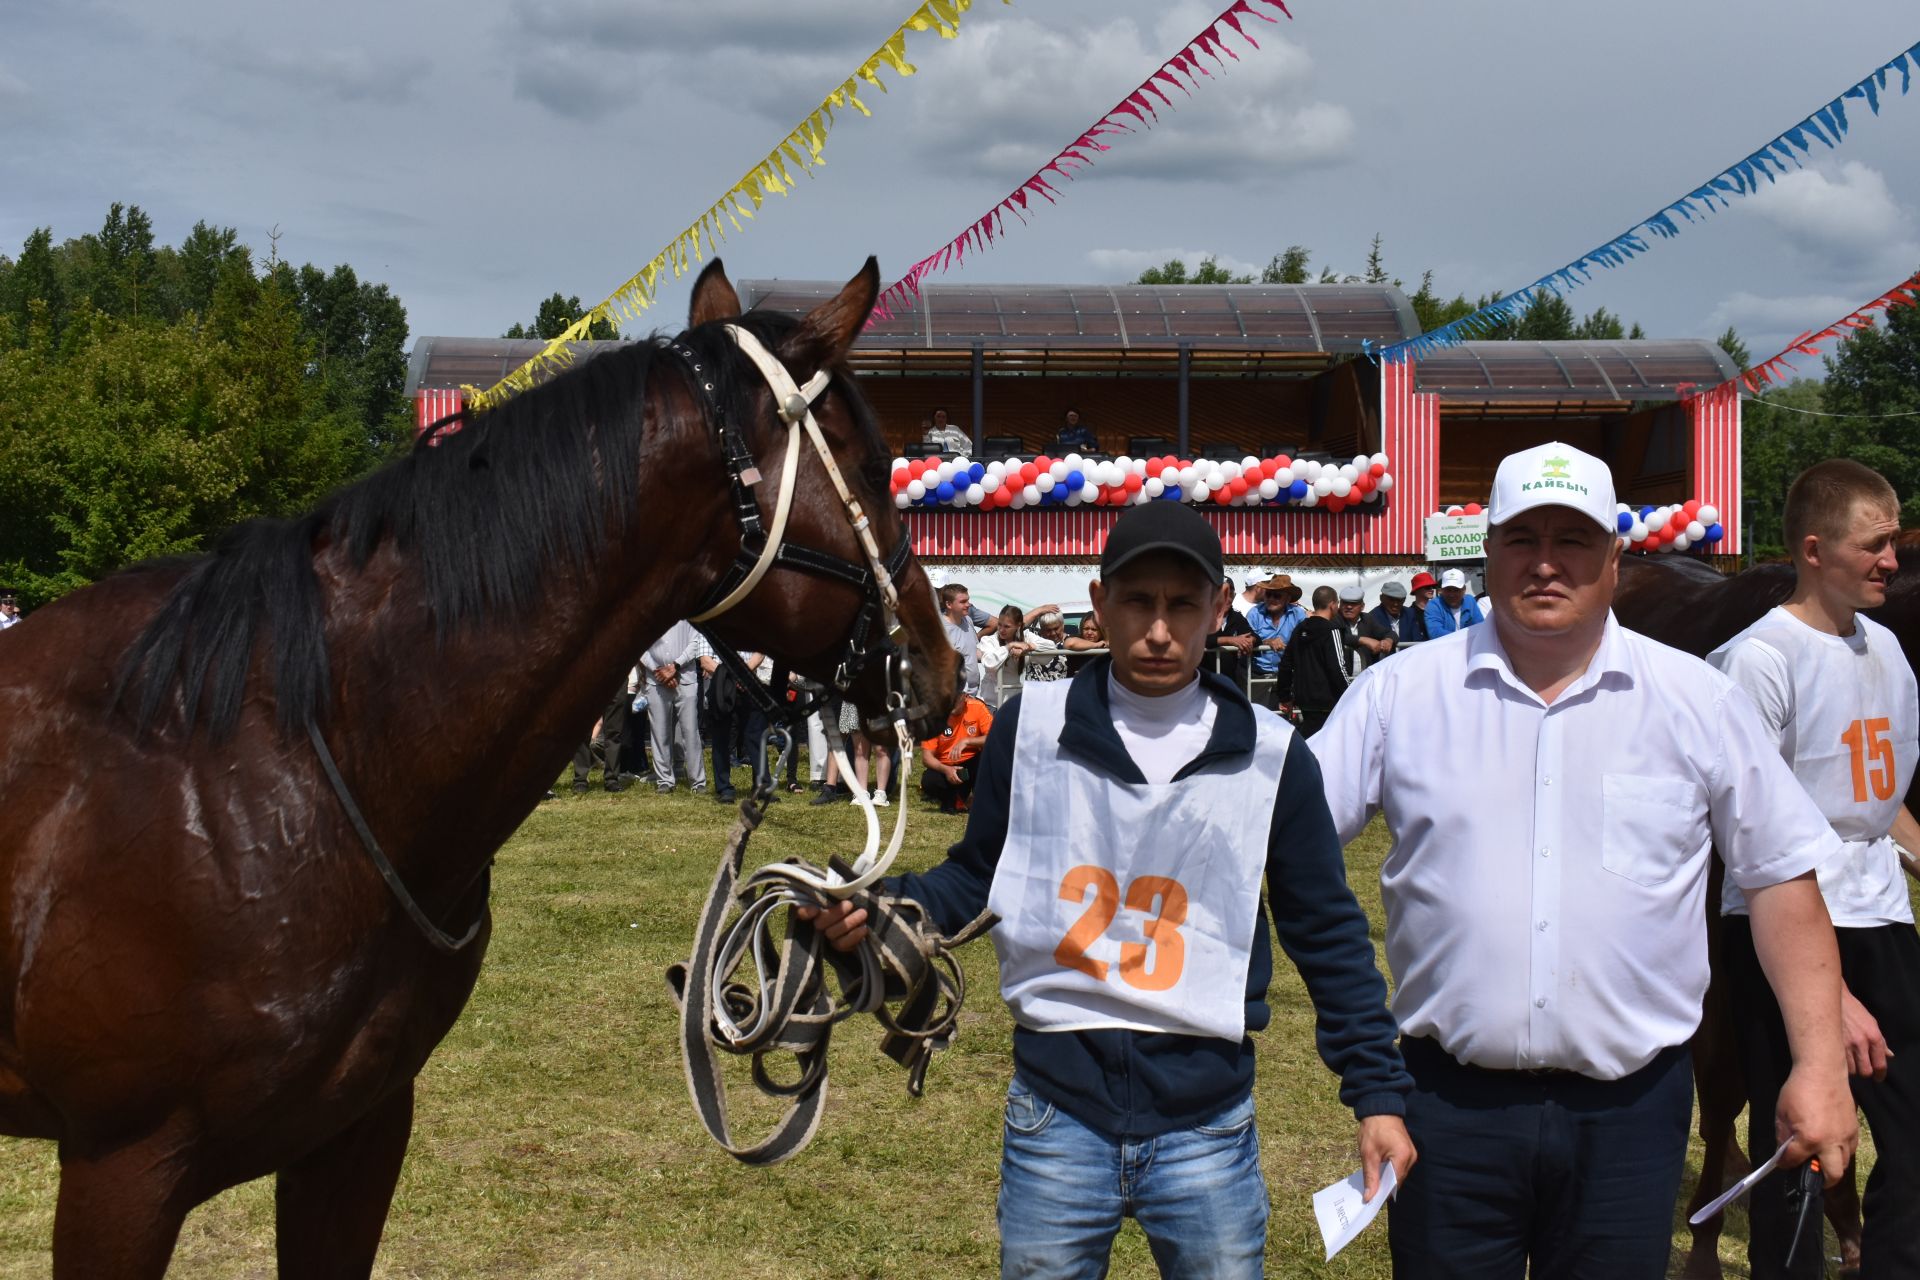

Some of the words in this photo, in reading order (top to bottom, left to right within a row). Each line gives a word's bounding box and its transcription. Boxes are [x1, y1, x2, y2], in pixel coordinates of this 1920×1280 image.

[1522, 478, 1588, 496] КАЙБЫЧ
[1432, 532, 1488, 545] АБСОЛЮТ
[1440, 544, 1482, 557] БАТЫР
[1841, 717, 1896, 803] 15
[1053, 864, 1189, 992] 23
